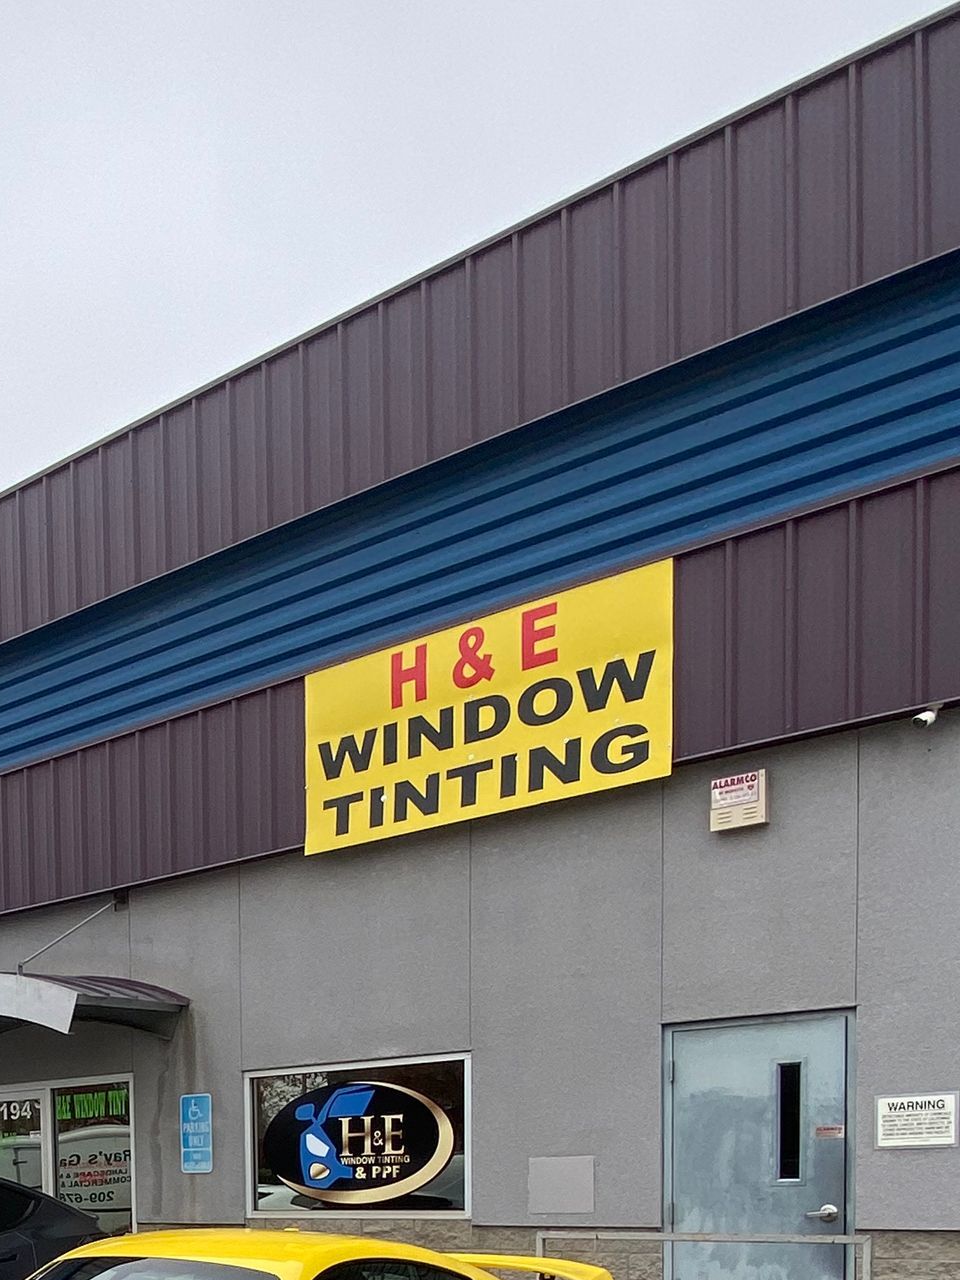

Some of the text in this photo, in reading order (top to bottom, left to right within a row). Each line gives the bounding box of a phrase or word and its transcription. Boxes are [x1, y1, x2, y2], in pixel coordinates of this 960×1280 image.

[391, 601, 558, 710] H & E
[318, 649, 656, 781] WINDOW
[323, 723, 650, 837] TINTING
[712, 773, 757, 790] ALARMCO
[73, 1091, 106, 1120] WINDOW
[887, 1099, 945, 1112] WARNING
[183, 1122, 210, 1134] PARKING
[340, 1155, 411, 1165] WINDOW TINTING
[355, 1165, 401, 1179] & PPF
